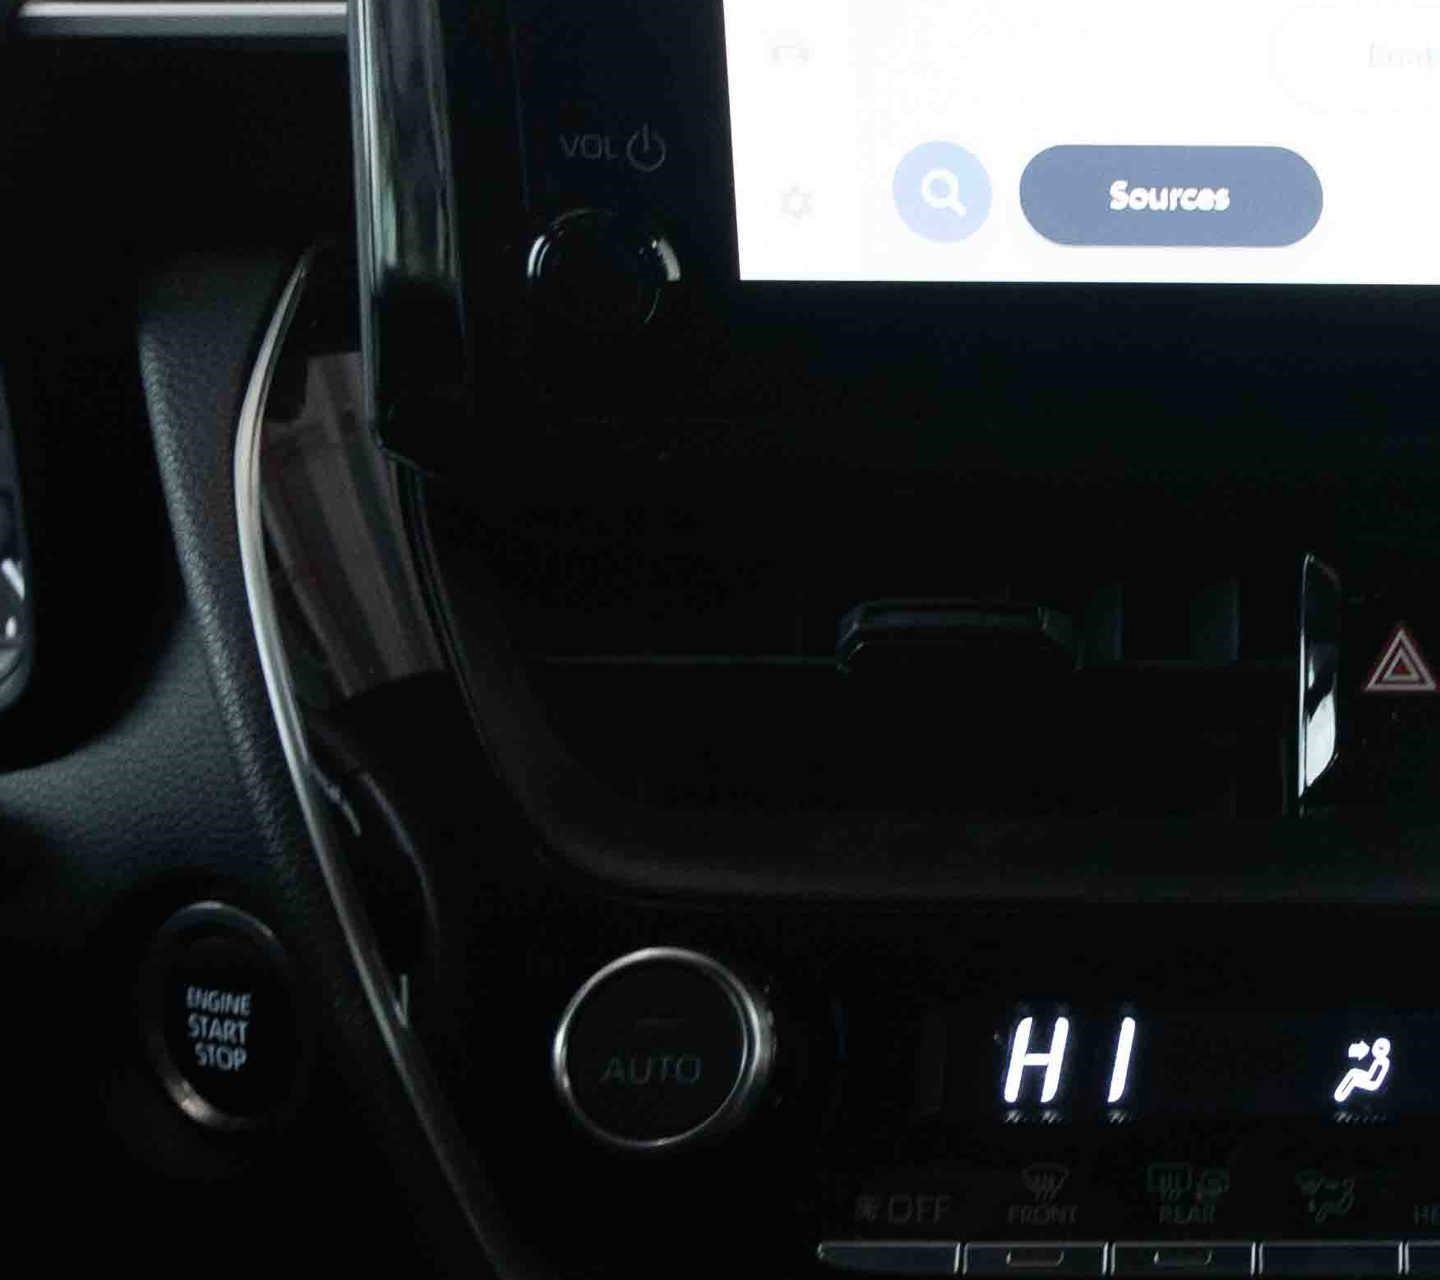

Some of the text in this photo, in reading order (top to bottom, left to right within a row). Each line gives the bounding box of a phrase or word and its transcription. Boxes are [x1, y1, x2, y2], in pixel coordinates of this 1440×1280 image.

[559, 134, 619, 161] VOL
[1109, 179, 1230, 211] Sources
[184, 984, 253, 1017] ENGINE
[186, 1014, 251, 1044] START
[193, 1041, 249, 1071] STOP
[599, 1052, 704, 1087] AUTO
[887, 1195, 951, 1224] OFF
[1008, 1204, 1079, 1224] FRONT
[1159, 1205, 1217, 1225] REAR
